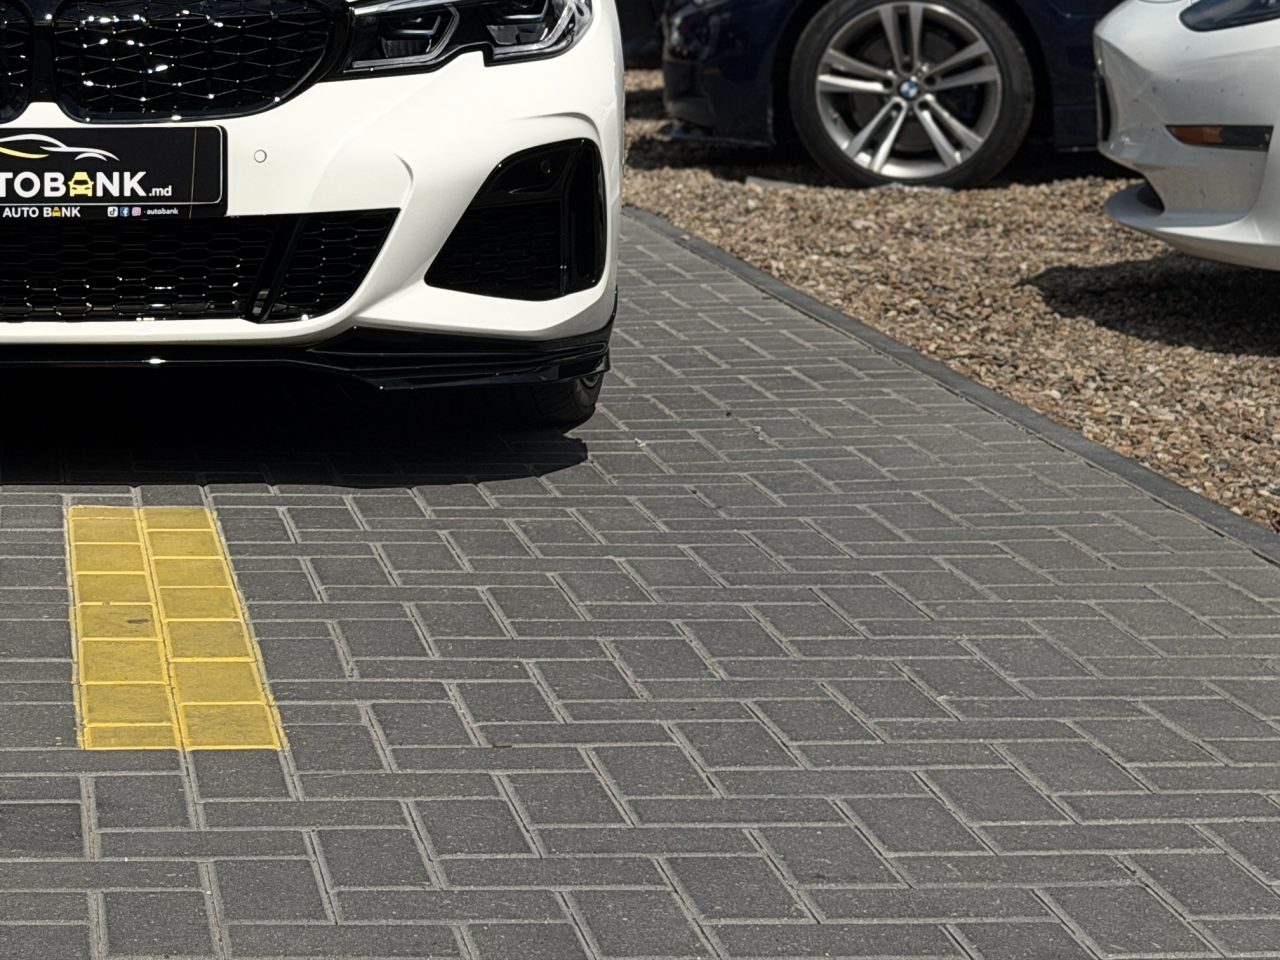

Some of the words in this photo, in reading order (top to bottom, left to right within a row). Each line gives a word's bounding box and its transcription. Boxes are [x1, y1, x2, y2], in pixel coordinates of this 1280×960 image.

[2, 206, 39, 218] AUTO
[43, 206, 81, 218] BANK
[146, 207, 179, 215] autobank
